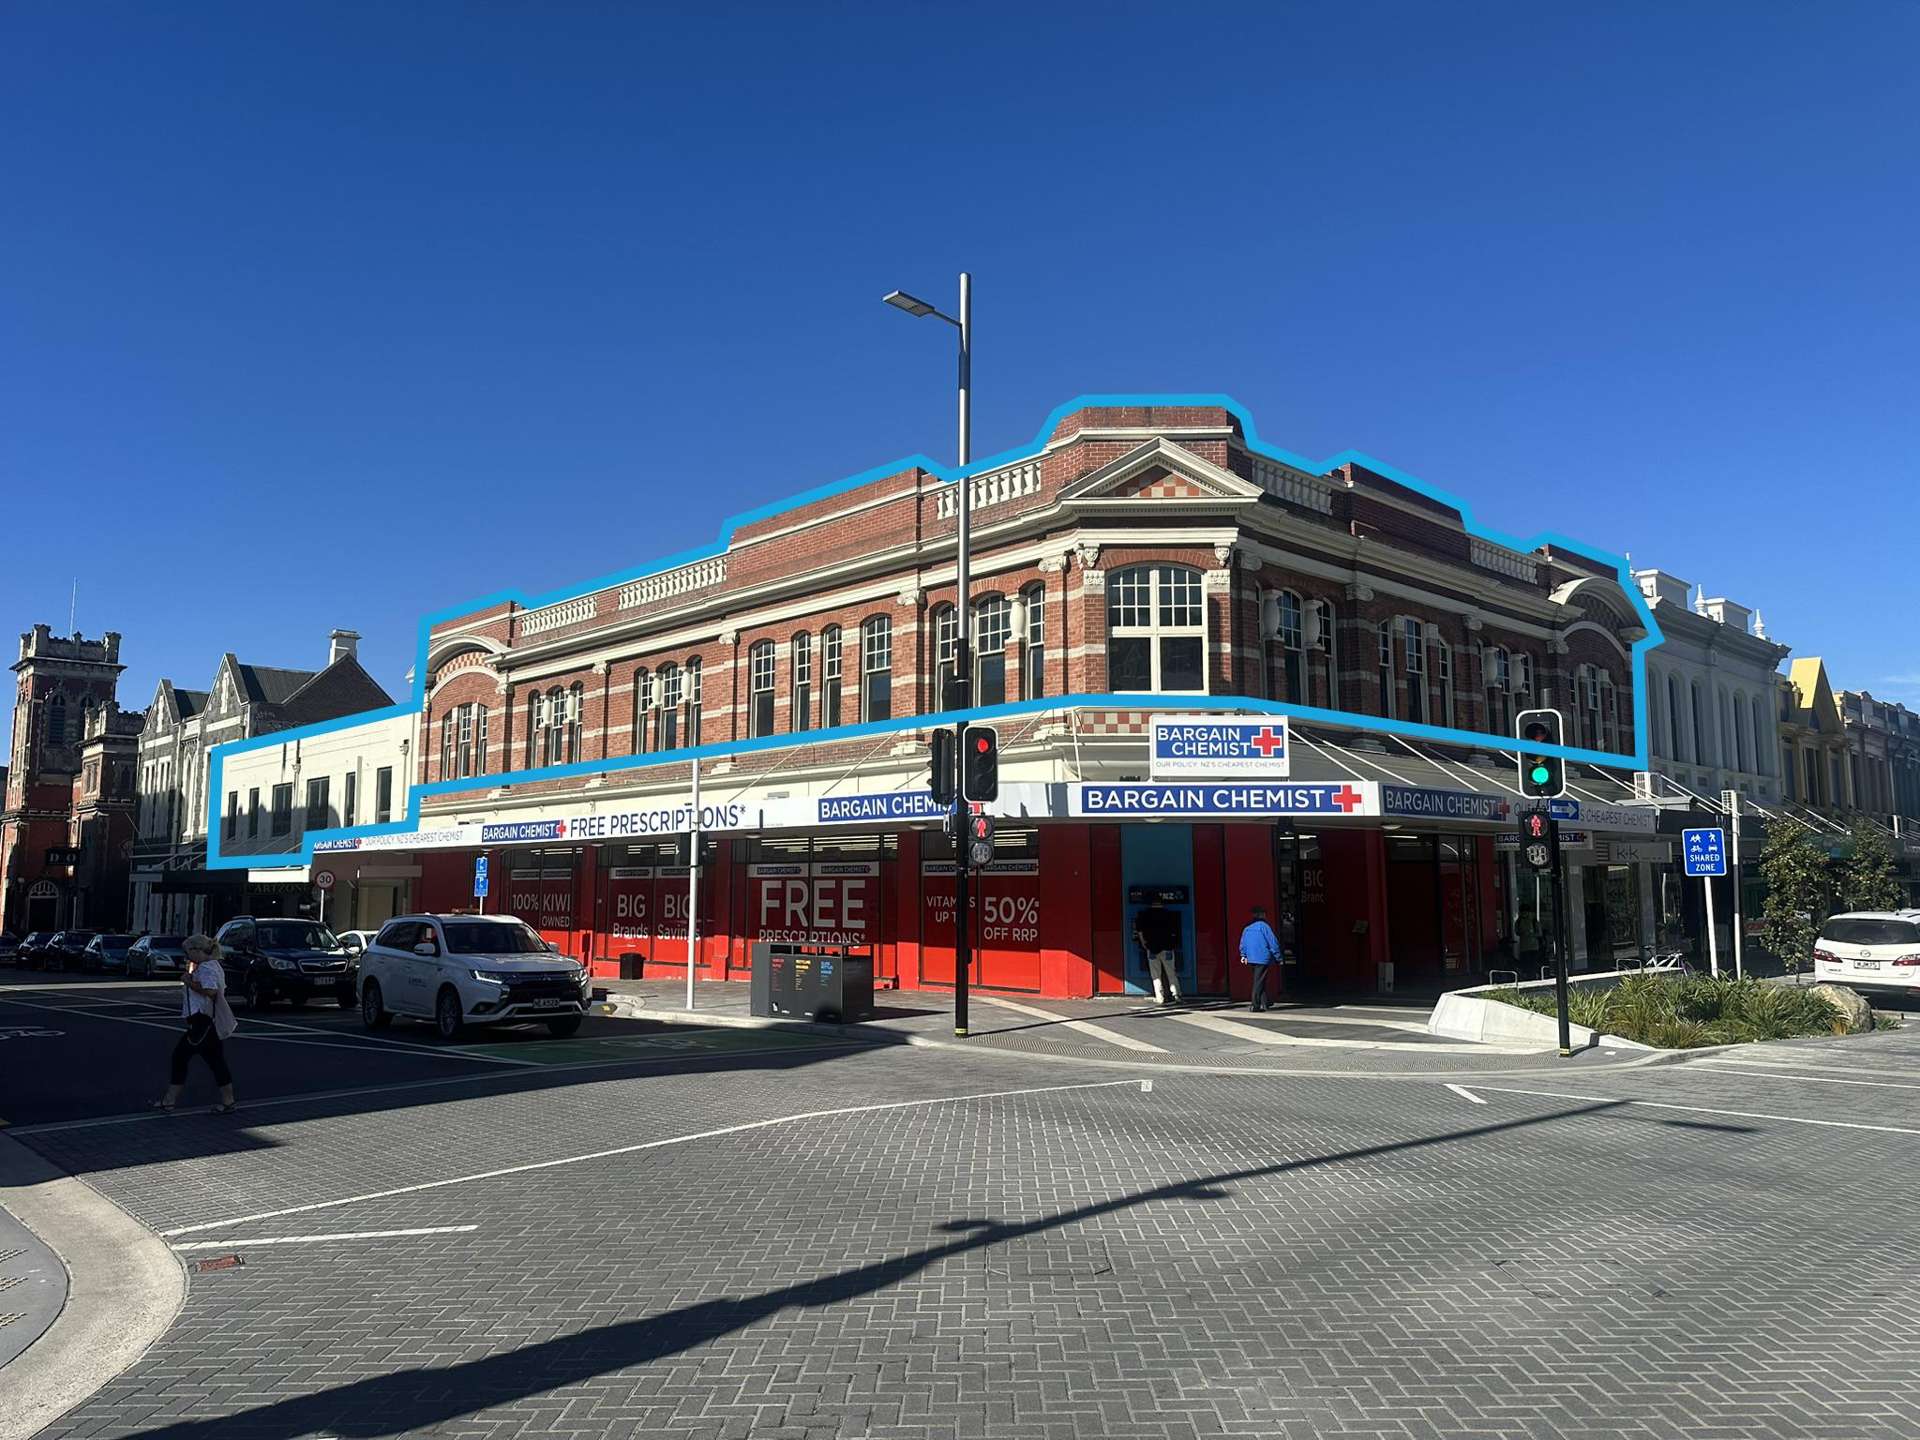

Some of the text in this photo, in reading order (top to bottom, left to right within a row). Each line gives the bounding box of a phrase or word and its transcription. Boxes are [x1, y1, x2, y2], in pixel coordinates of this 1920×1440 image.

[1157, 728, 1240, 742] BARGAIN
[1172, 742, 1250, 756] CHEMIST
[1088, 789, 1325, 809] BARGAIN CHEMIST
[1386, 791, 1442, 814] BARGAIN
[1447, 797, 1496, 817] CHEMIST
[821, 799, 887, 818] BARGAIN
[570, 804, 746, 837] FREE PRESCRIPTONS
[483, 823, 555, 840] BARGAIN CHEMIST
[1690, 854, 1720, 862] SHARED
[1696, 863, 1716, 872] ZONE
[319, 875, 331, 883] 30
[512, 893, 571, 911] 100% KIWI
[617, 894, 646, 918] BIG
[761, 879, 866, 928] FREE
[926, 895, 976, 908] VITAMS
[541, 916, 570, 928] OWNED
[935, 911, 949, 923] UP
[612, 922, 649, 939] Brands
[657, 923, 700, 942] Savins
[759, 929, 866, 944] PRESCRPTIONS
[984, 926, 1038, 941] OFF RRP
